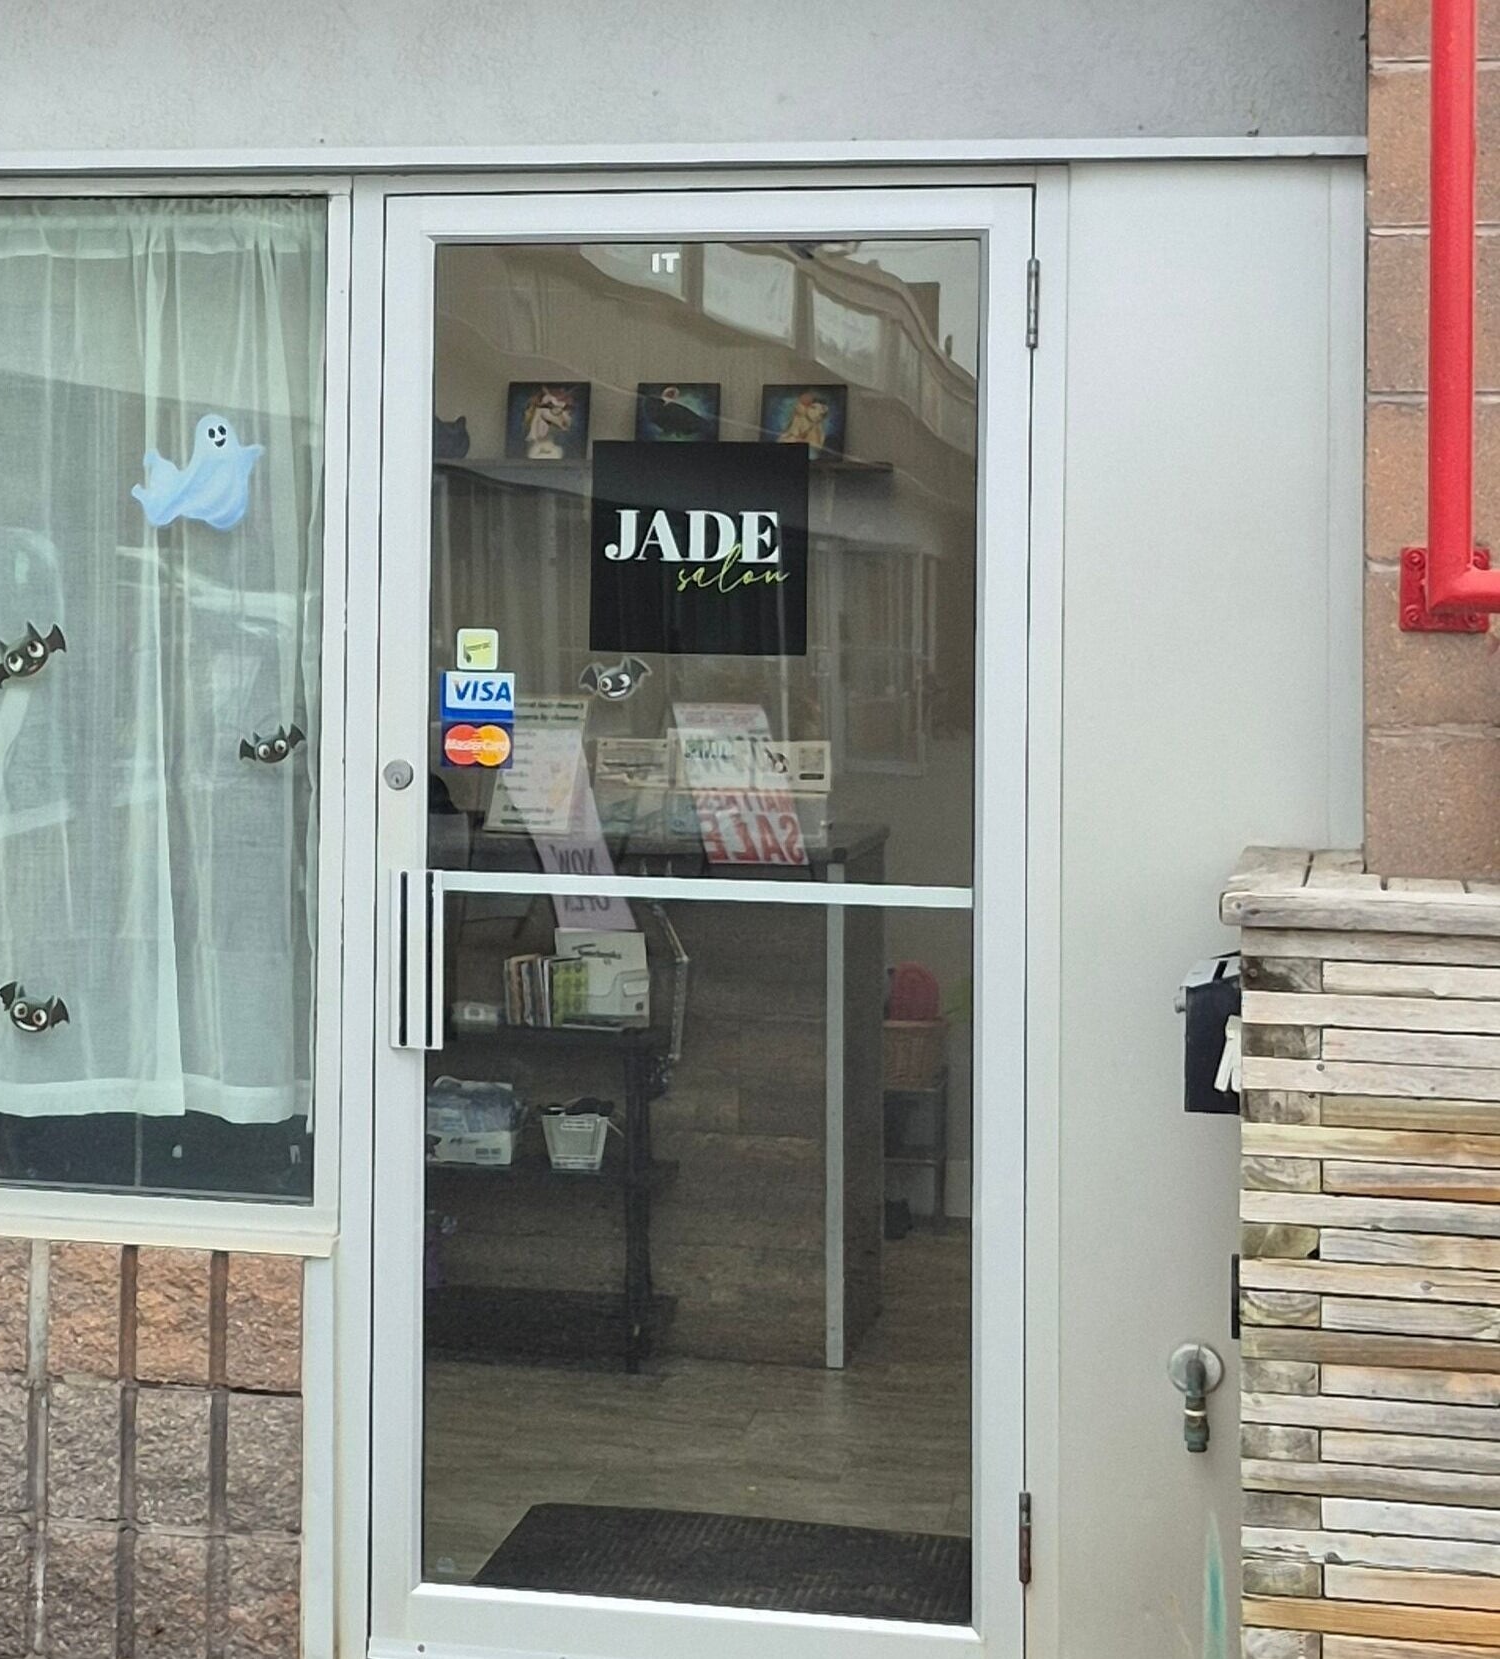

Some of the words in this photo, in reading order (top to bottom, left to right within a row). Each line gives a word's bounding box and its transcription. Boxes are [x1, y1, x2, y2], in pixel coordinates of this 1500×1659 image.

[604, 509, 780, 563] JADE
[676, 543, 789, 593] salon
[454, 680, 512, 702] VISA
